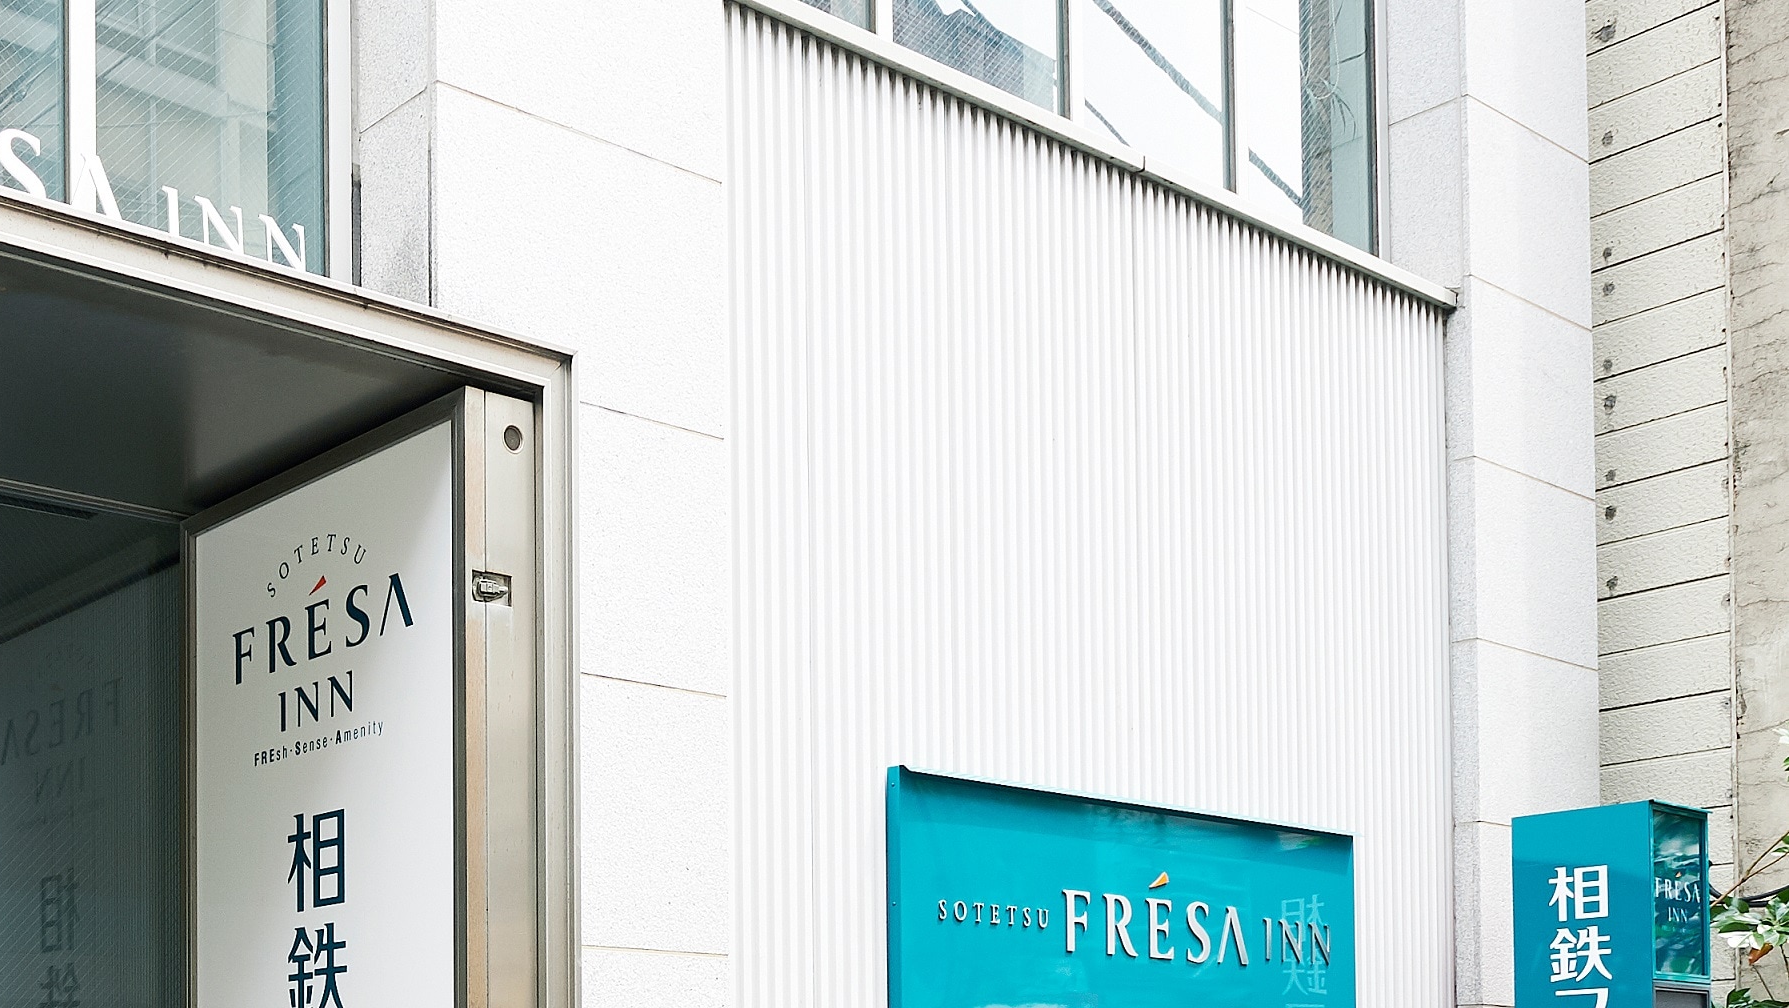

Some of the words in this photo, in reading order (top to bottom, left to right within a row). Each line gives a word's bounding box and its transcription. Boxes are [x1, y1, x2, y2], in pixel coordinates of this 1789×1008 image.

[161, 185, 307, 272] INN
[266, 532, 366, 598] SOTETSU
[232, 572, 414, 686] FRÉSA
[277, 670, 354, 732] INN
[938, 898, 1050, 930] SOTETSU
[1062, 871, 1250, 966] FRÉSA
[1262, 917, 1332, 968] INN
[1668, 906, 1688, 923] INN
